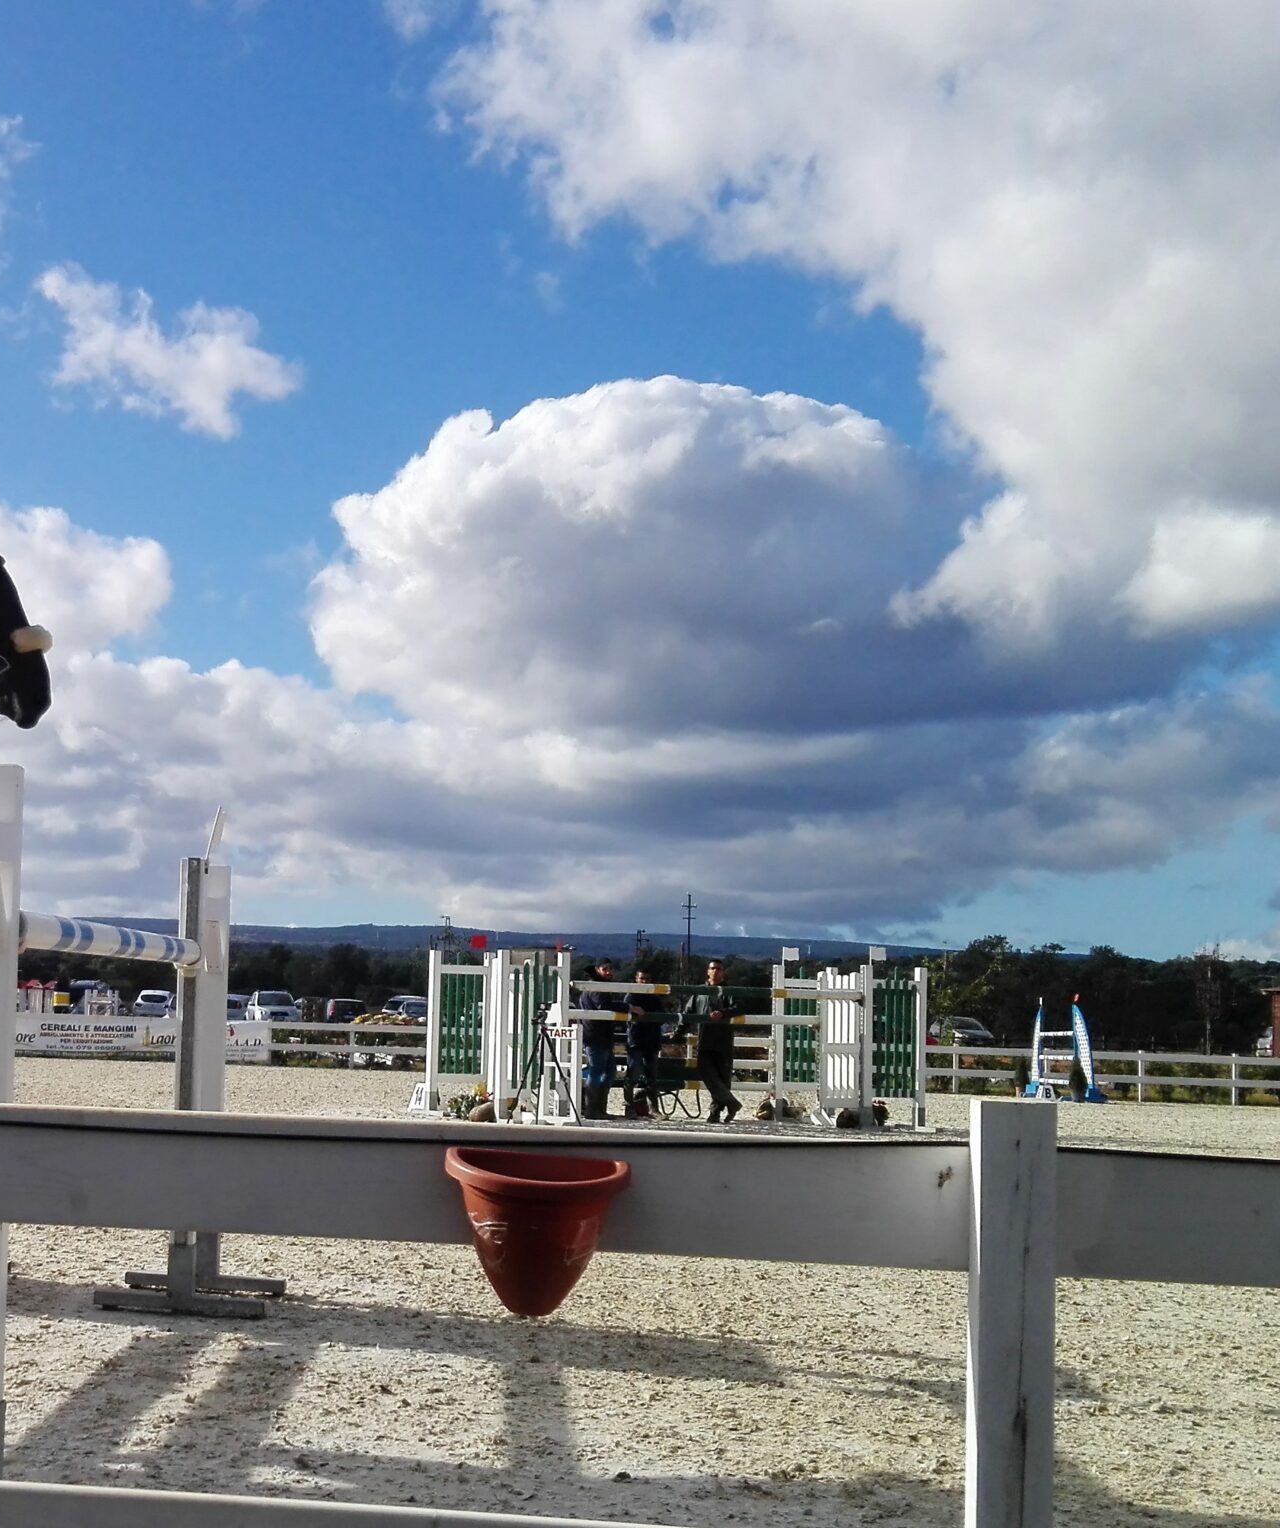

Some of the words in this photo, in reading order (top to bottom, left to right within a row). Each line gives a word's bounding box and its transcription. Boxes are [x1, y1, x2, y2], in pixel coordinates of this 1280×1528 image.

[40, 1023, 81, 1032] CEREALI
[93, 1025, 137, 1033] MANGIMI
[15, 1033, 36, 1043] ore
[1045, 1088, 1052, 1098] B
